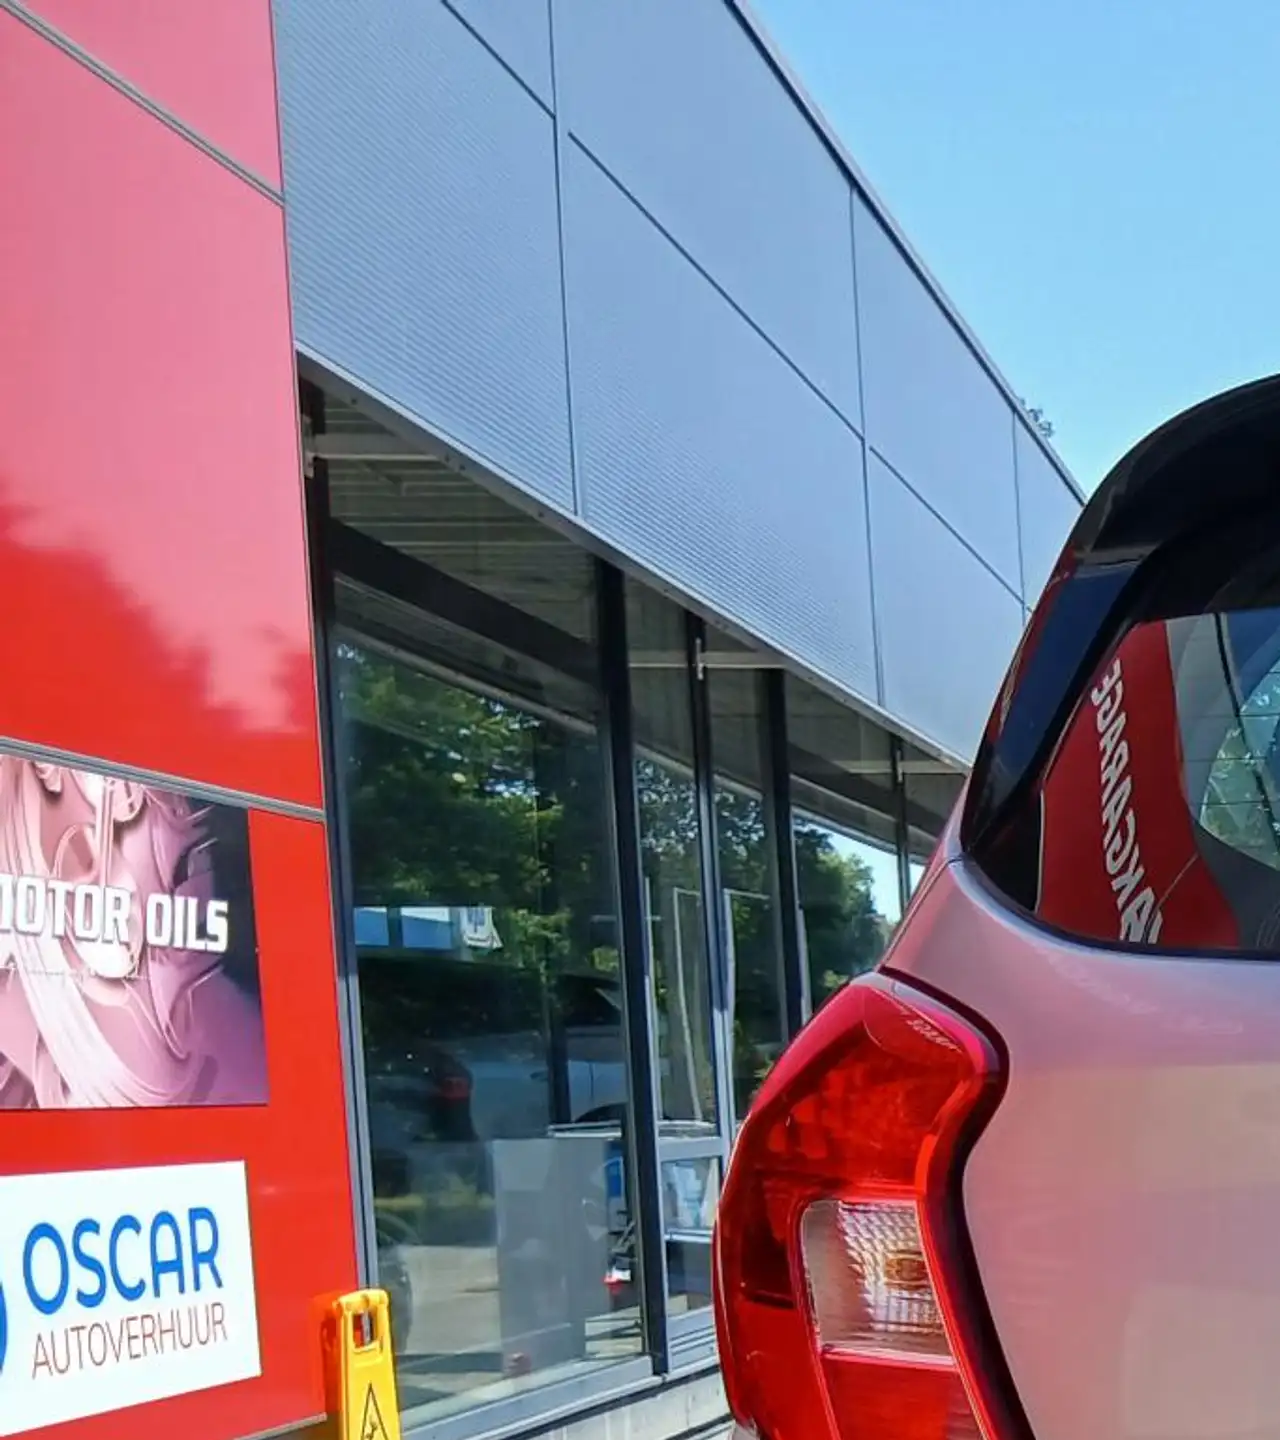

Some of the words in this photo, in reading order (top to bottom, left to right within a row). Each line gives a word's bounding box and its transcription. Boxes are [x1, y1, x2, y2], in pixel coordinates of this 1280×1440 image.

[146, 893, 229, 953] OILS
[23, 1207, 223, 1315] OSCAR
[32, 1302, 228, 1380] AUTOVERHUUR
